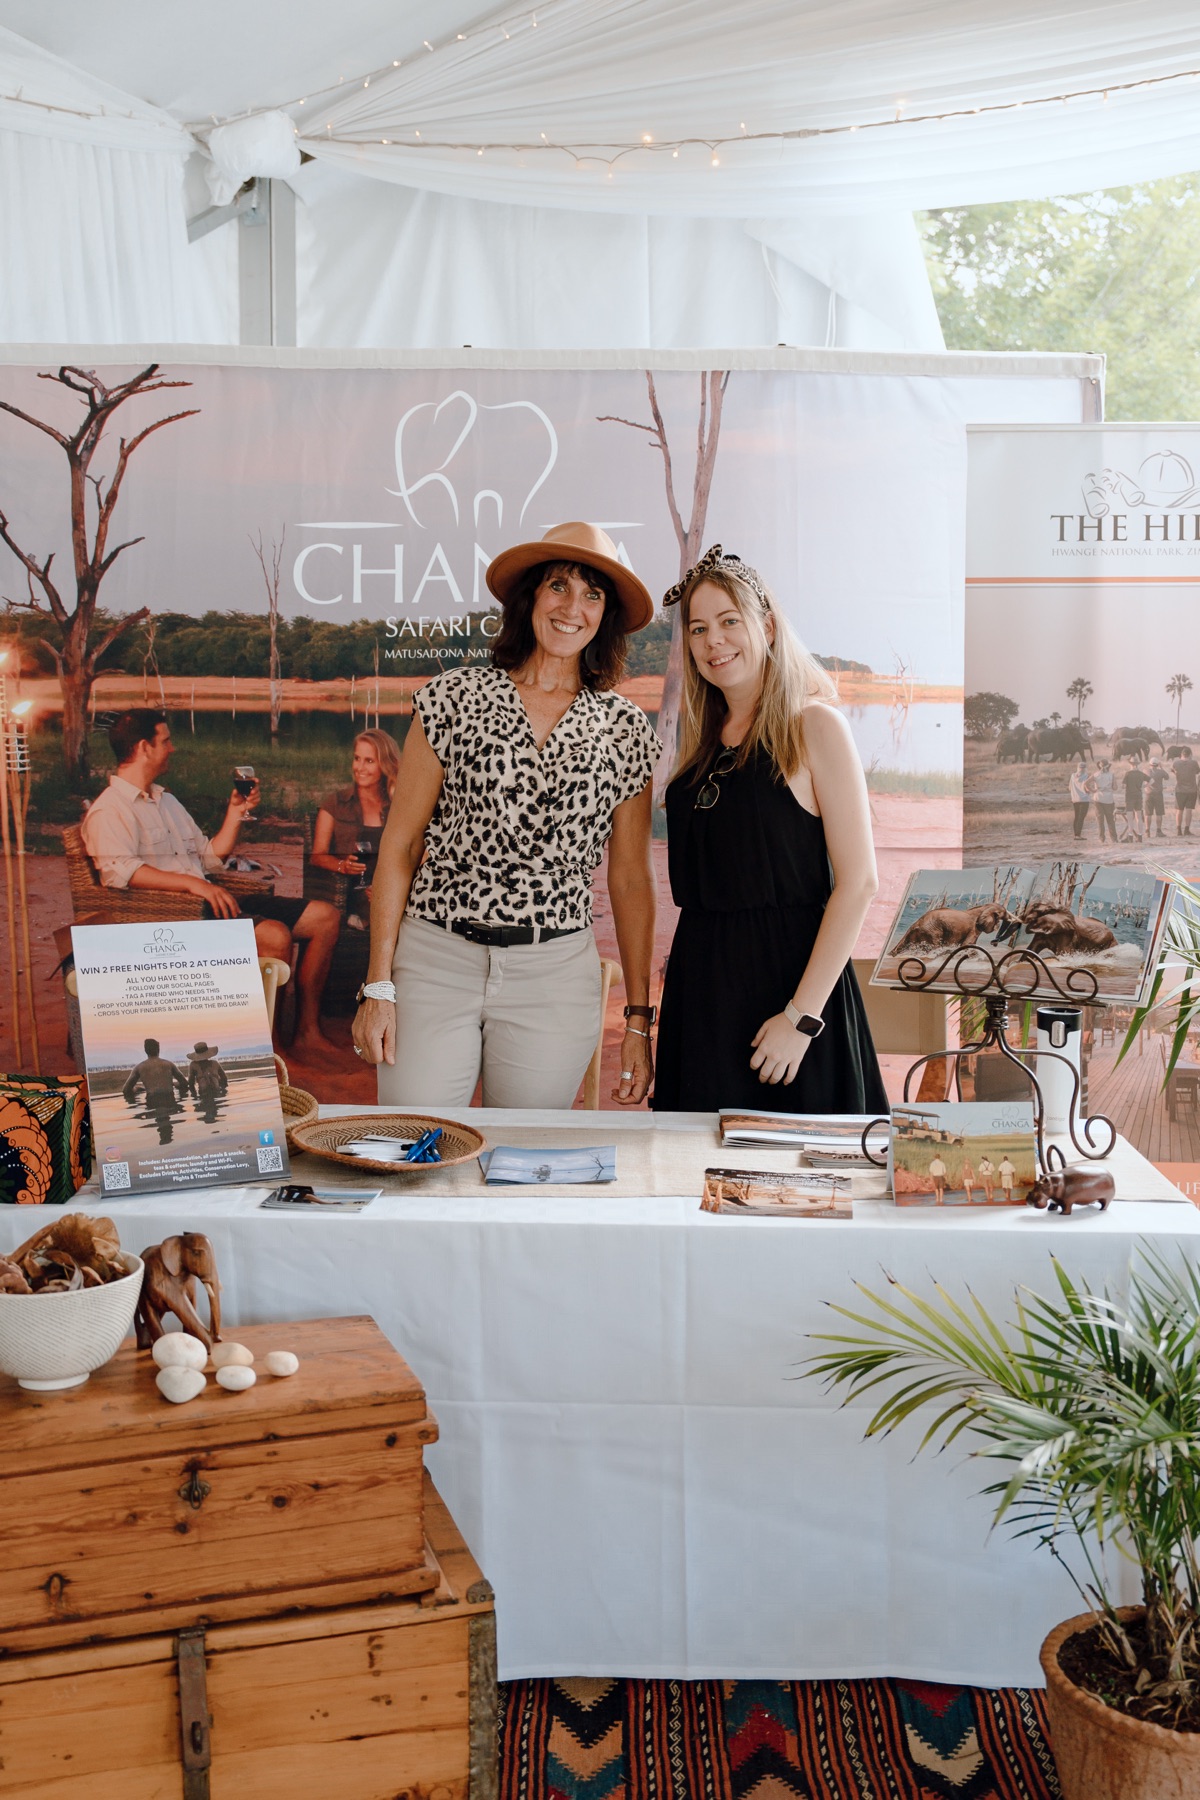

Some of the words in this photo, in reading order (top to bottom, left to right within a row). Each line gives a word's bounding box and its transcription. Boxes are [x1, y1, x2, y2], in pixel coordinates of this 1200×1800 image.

[1050, 514, 1128, 542] THE
[1051, 547, 1097, 557] HWANGE
[1100, 547, 1152, 557] NATIONAL
[293, 541, 634, 604] CHA
[385, 615, 471, 638] SAFARI
[384, 648, 465, 659] MATUSADONA
[467, 648, 495, 659] NATI
[143, 943, 187, 954] CHANGA
[80, 966, 100, 975] WIN
[134, 963, 167, 971] NIGHTS
[210, 957, 251, 966] CHANGA!
[140, 1006, 166, 1014] FINGERS
[992, 1120, 1030, 1129] CHANGA
